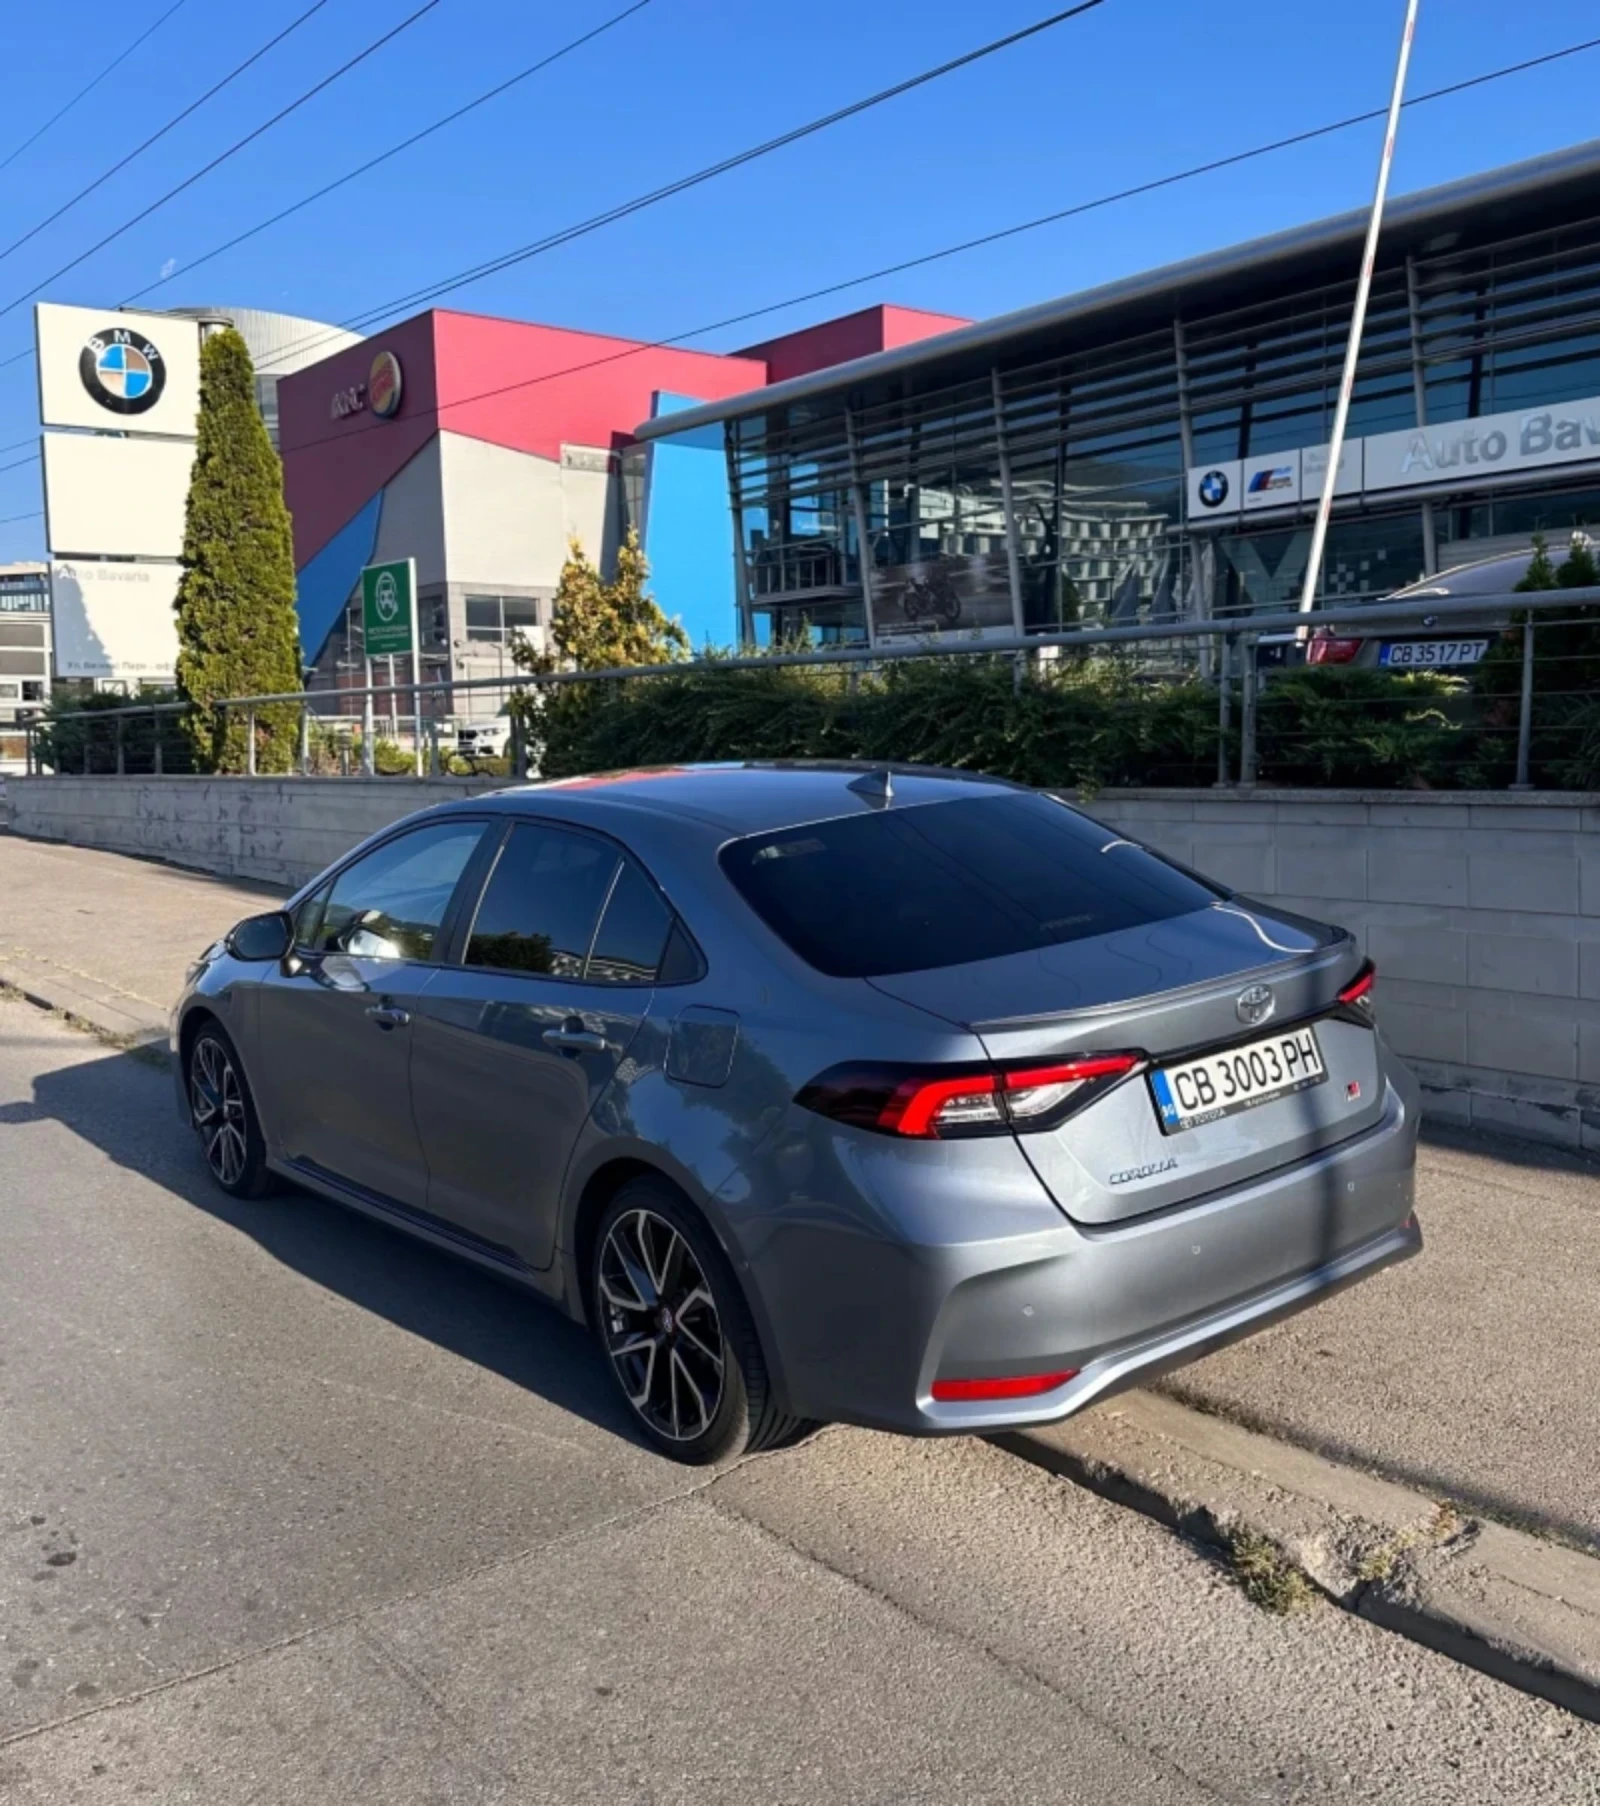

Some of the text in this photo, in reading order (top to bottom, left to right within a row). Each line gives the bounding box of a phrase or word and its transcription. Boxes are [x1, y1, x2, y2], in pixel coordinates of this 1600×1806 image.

[88, 329, 159, 361] BMW
[1402, 428, 1507, 473] Auto
[59, 564, 93, 580] Auo
[1391, 642, 1485, 663] CB 3517 PT
[1174, 1033, 1319, 1111] CB 3003 PH
[1108, 1157, 1179, 1185] COROLLA
